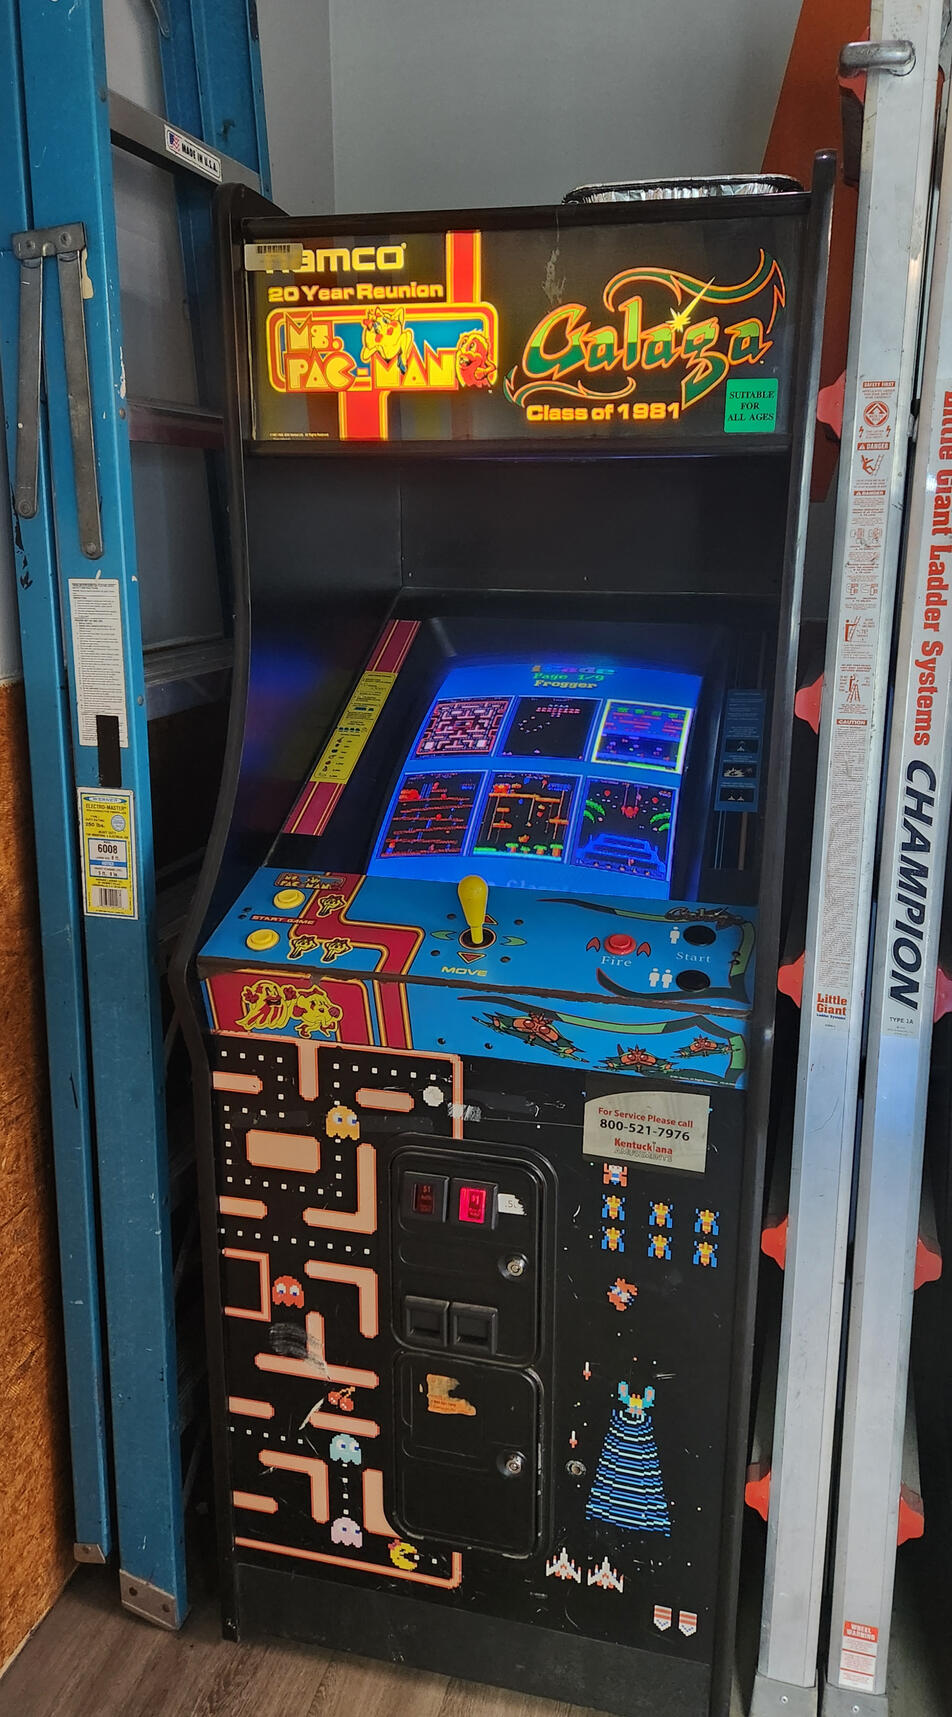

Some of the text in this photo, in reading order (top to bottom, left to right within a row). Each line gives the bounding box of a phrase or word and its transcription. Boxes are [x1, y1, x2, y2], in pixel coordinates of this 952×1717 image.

[181, 143, 196, 160] MADE
[268, 281, 444, 302] 20 Year Reunion
[522, 295, 774, 410] Galaga
[286, 342, 458, 390] PAC-MAN
[729, 390, 775, 400] SUITABLE
[526, 402, 680, 421] Class of 1981
[741, 402, 760, 410] FOR
[728, 413, 775, 421] ALL AGES
[923, 545, 952, 632] Ladder
[533, 672, 604, 681] Page 1/9
[534, 680, 598, 689] Frogger
[914, 640, 944, 746] Systems
[97, 843, 118, 855] 6008
[889, 759, 937, 1011] CHAMPION
[601, 955, 632, 968] Fire
[675, 951, 711, 963] Start
[441, 966, 488, 977] MOVE
[817, 993, 847, 1005] Little
[816, 1003, 846, 1016] Giant
[598, 1107, 694, 1128] For Service Please call
[600, 1118, 690, 1142] 800-521-7976
[614, 1138, 673, 1155] Kentuckiana
